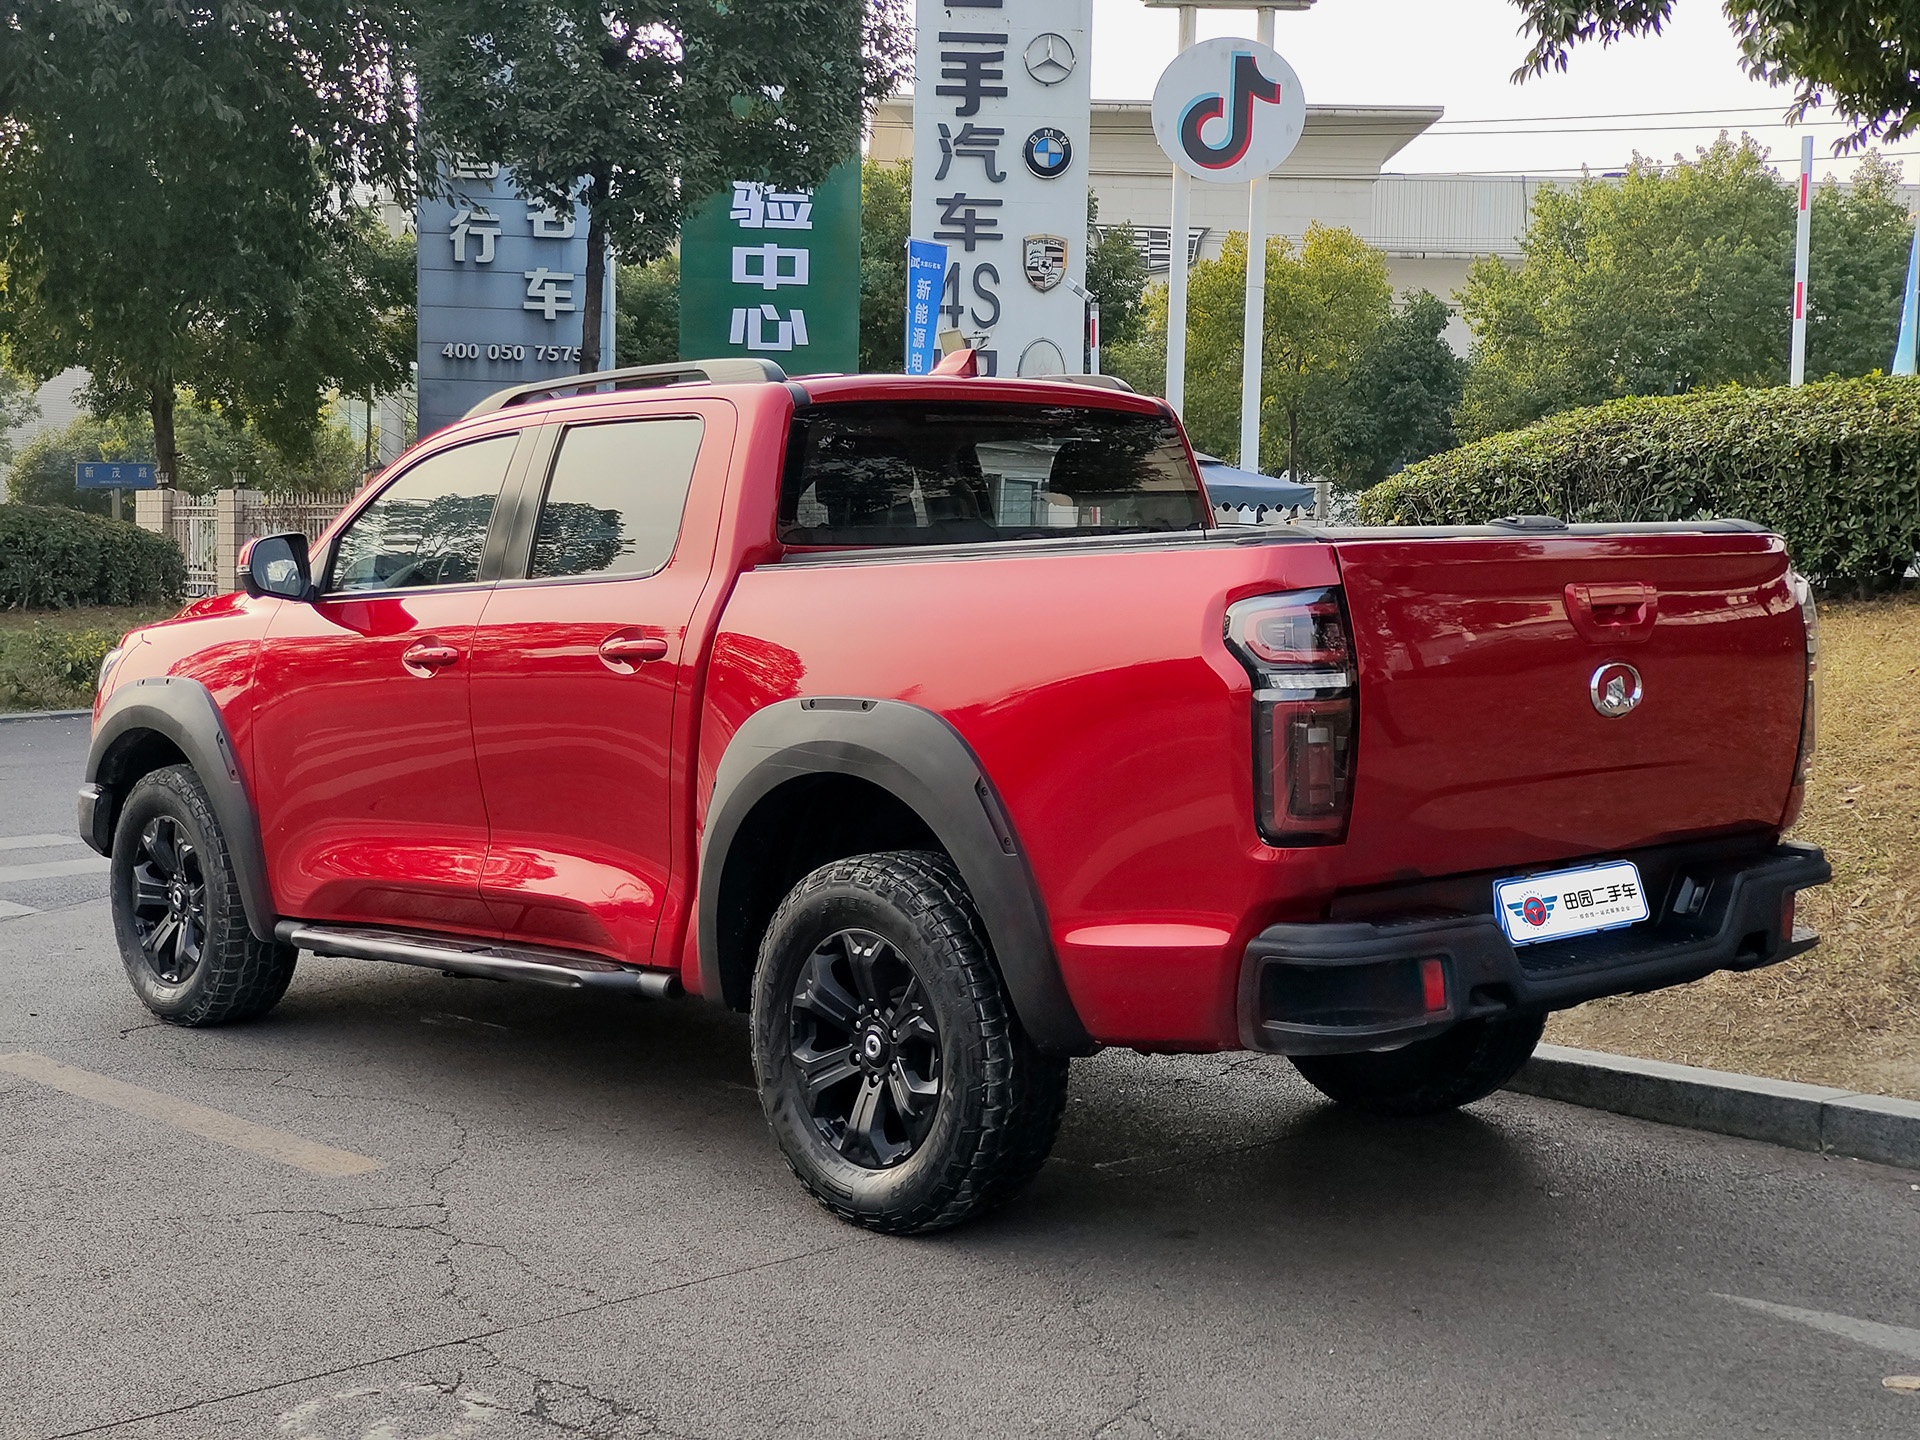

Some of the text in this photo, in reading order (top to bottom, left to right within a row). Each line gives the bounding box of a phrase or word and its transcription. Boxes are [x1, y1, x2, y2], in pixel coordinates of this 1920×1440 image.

[1030, 130, 1069, 146] BMW
[1026, 239, 1065, 248] PORSCHE
[442, 342, 581, 363] 400 050 7575
[84, 466, 148, 478] 新茂路
[1563, 883, 1638, 910] 田园二手车
